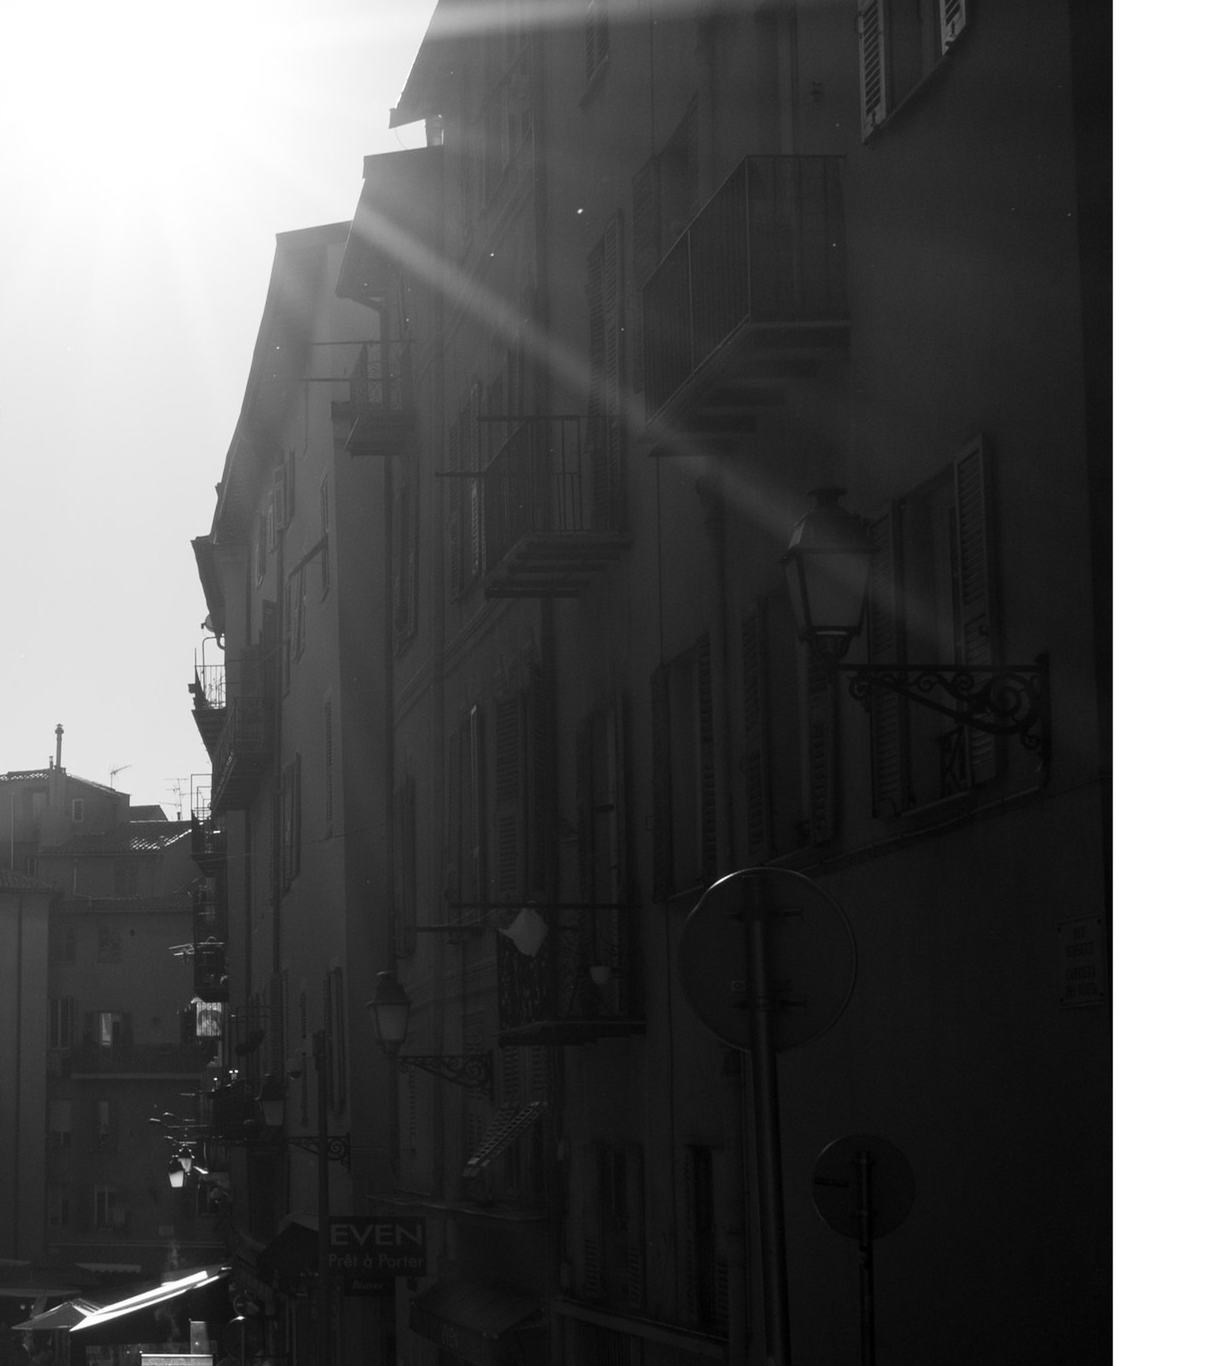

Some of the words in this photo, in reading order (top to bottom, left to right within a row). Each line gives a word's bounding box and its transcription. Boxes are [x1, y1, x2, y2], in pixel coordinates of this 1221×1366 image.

[330, 1223, 422, 1246] EVEN
[329, 1253, 357, 1268] Prêt
[379, 1253, 424, 1268] Porter
